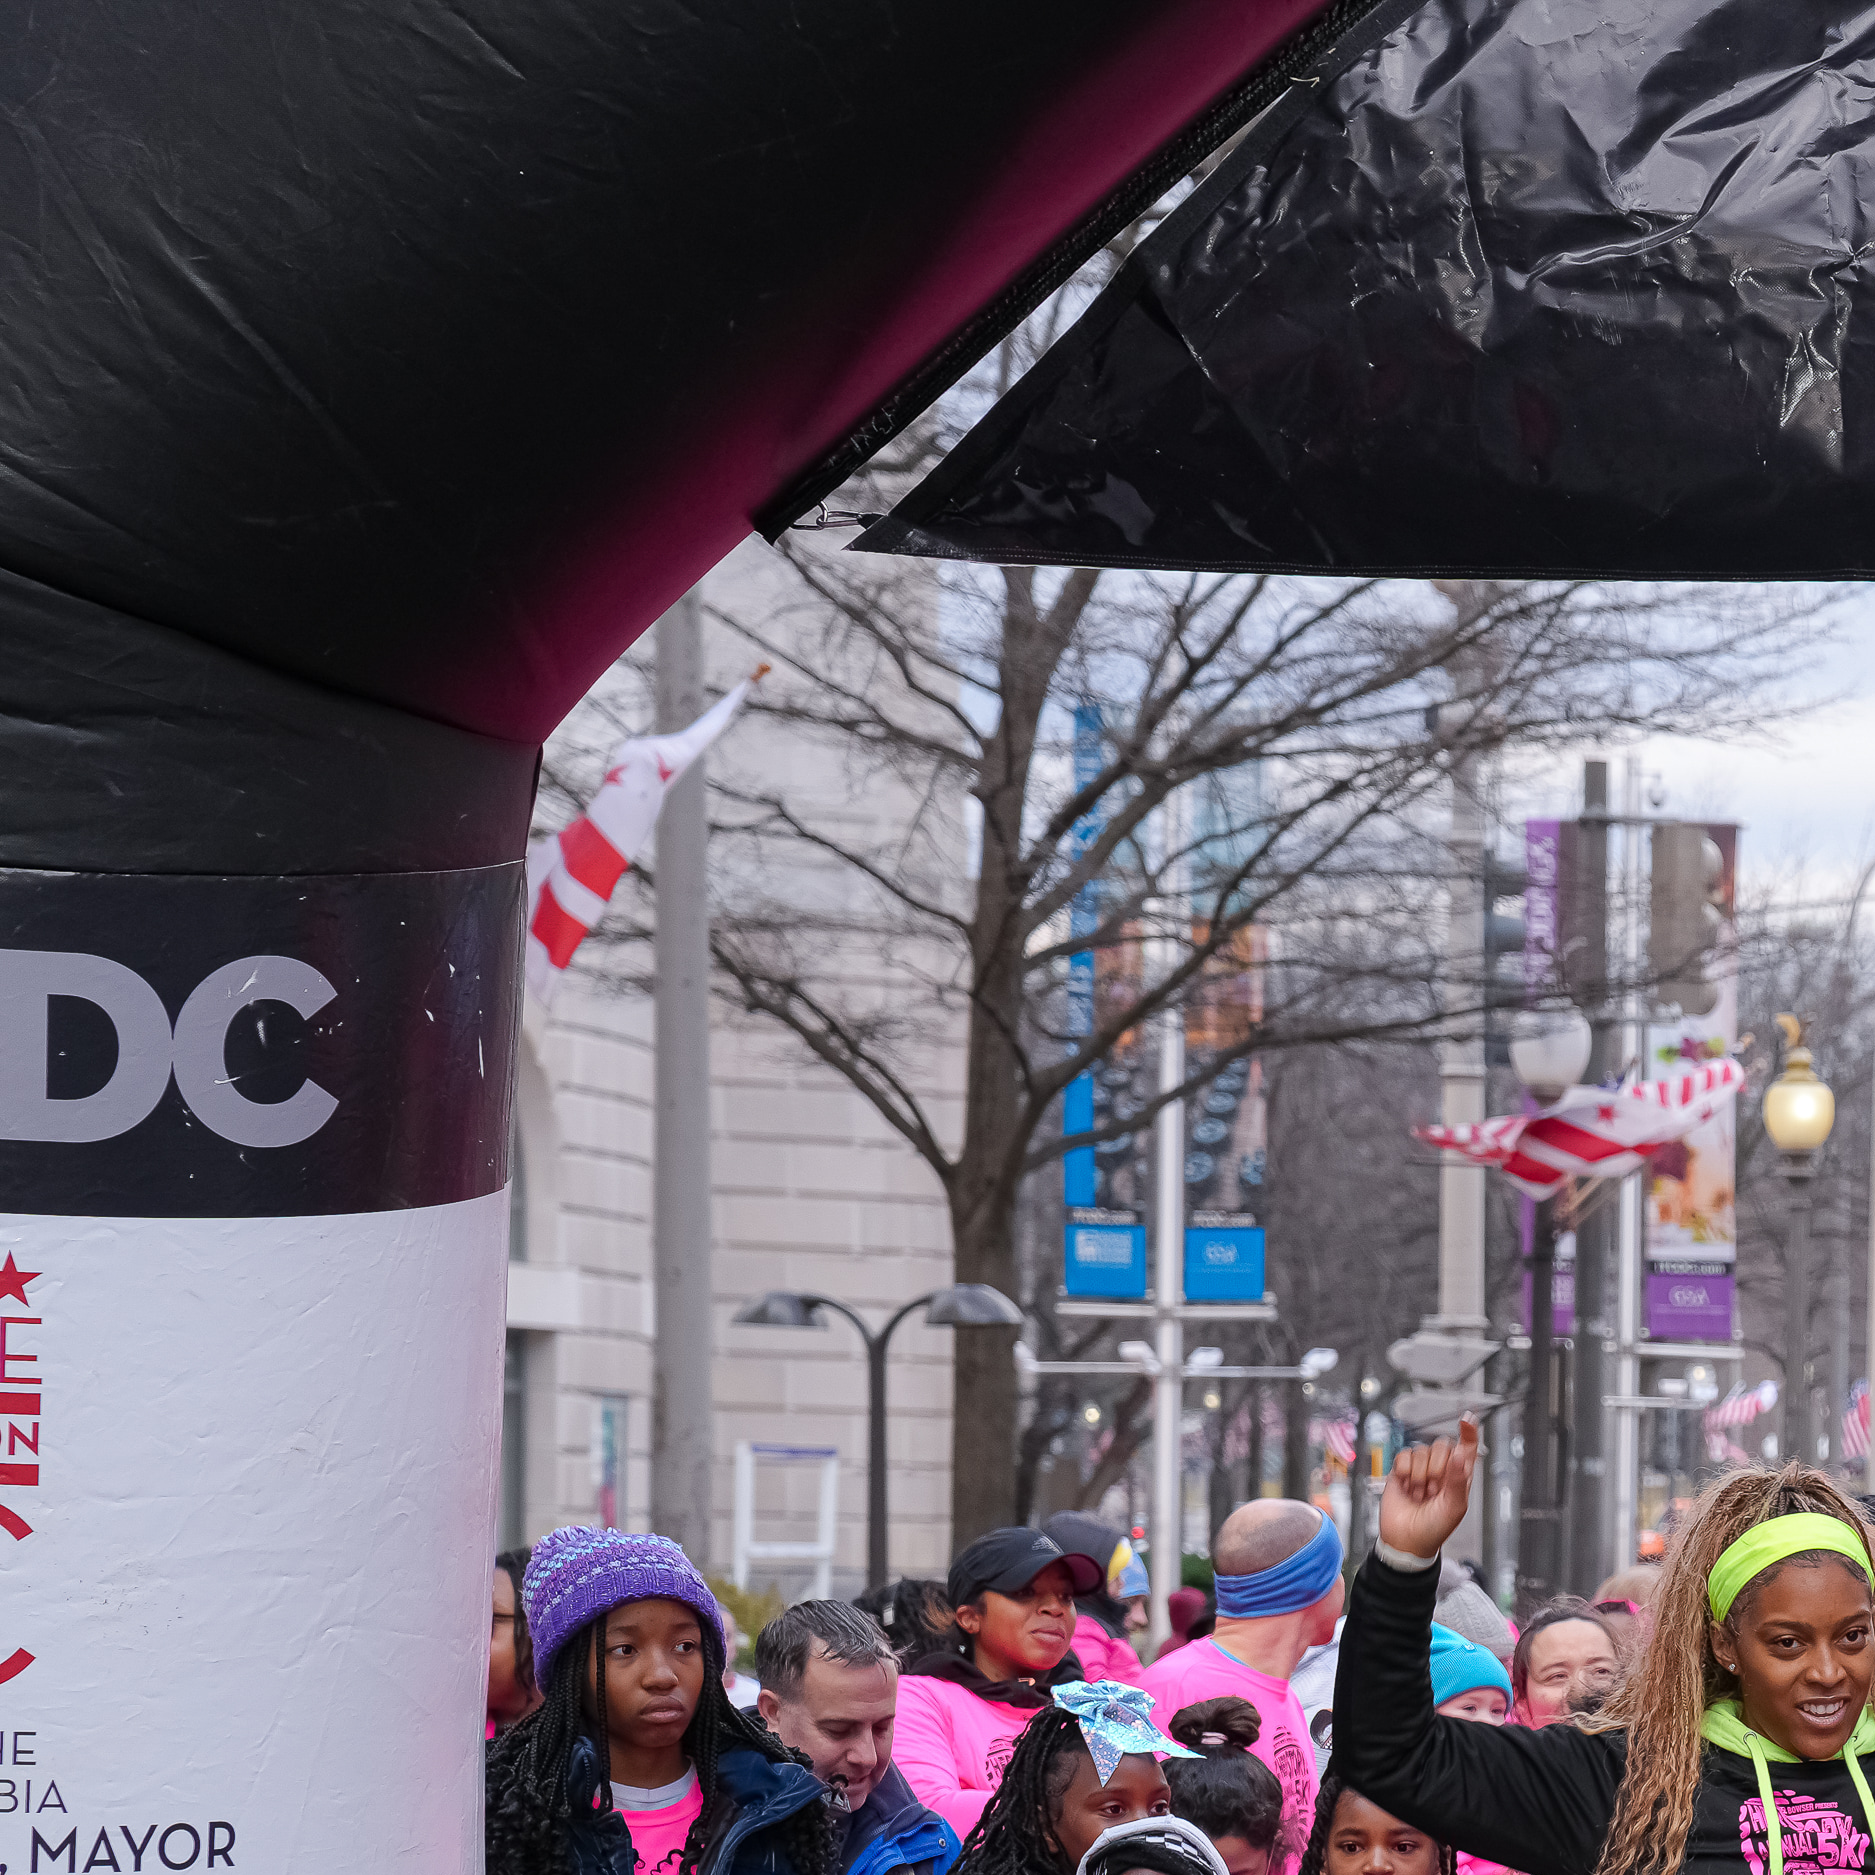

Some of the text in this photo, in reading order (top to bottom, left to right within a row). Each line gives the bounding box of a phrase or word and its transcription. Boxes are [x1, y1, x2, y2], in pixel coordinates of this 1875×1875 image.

[1787, 1802, 1814, 1814] BOWSER
[30, 1821, 236, 1874] MAYOR
[1818, 1832, 1861, 1868] 5K
